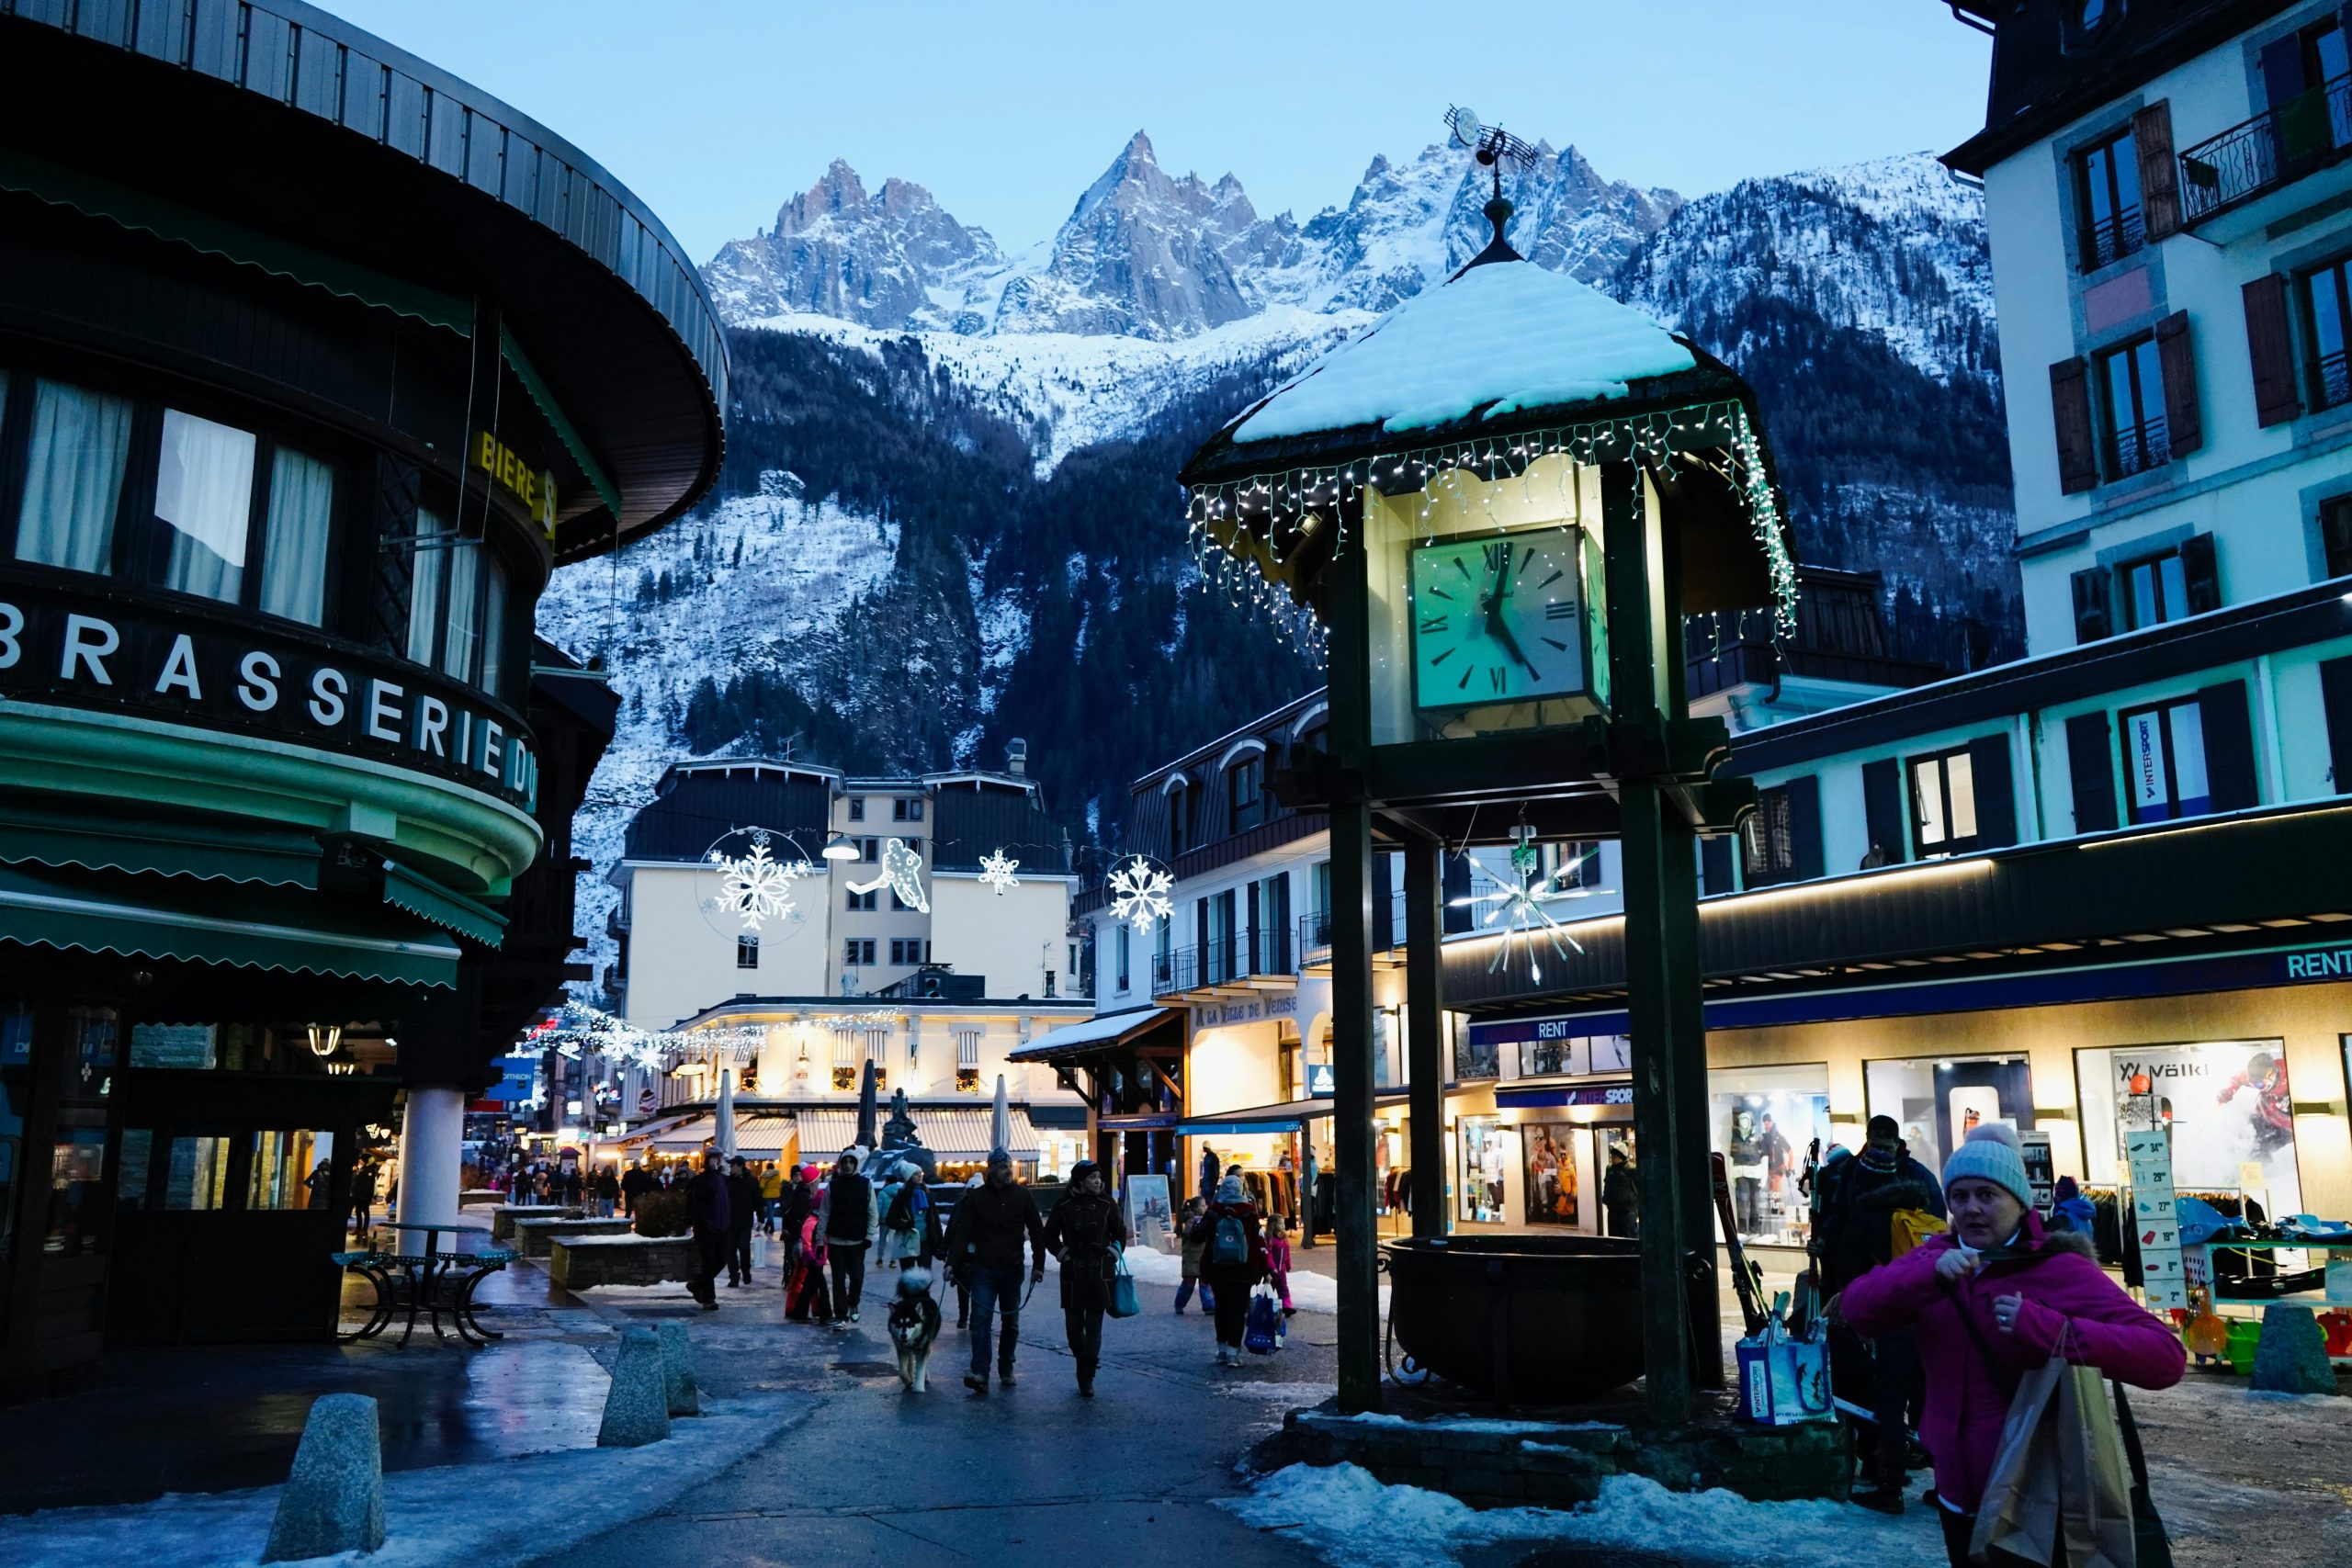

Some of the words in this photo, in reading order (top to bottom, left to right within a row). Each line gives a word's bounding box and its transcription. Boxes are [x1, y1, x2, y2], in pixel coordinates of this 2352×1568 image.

[2138, 719, 2154, 785] INTERSPORT
[514, 738, 537, 803] DU
[2287, 949, 2352, 978] RENT
[1538, 1021, 1568, 1038] RENT
[1577, 1088, 1634, 1104] INTERSPOR
